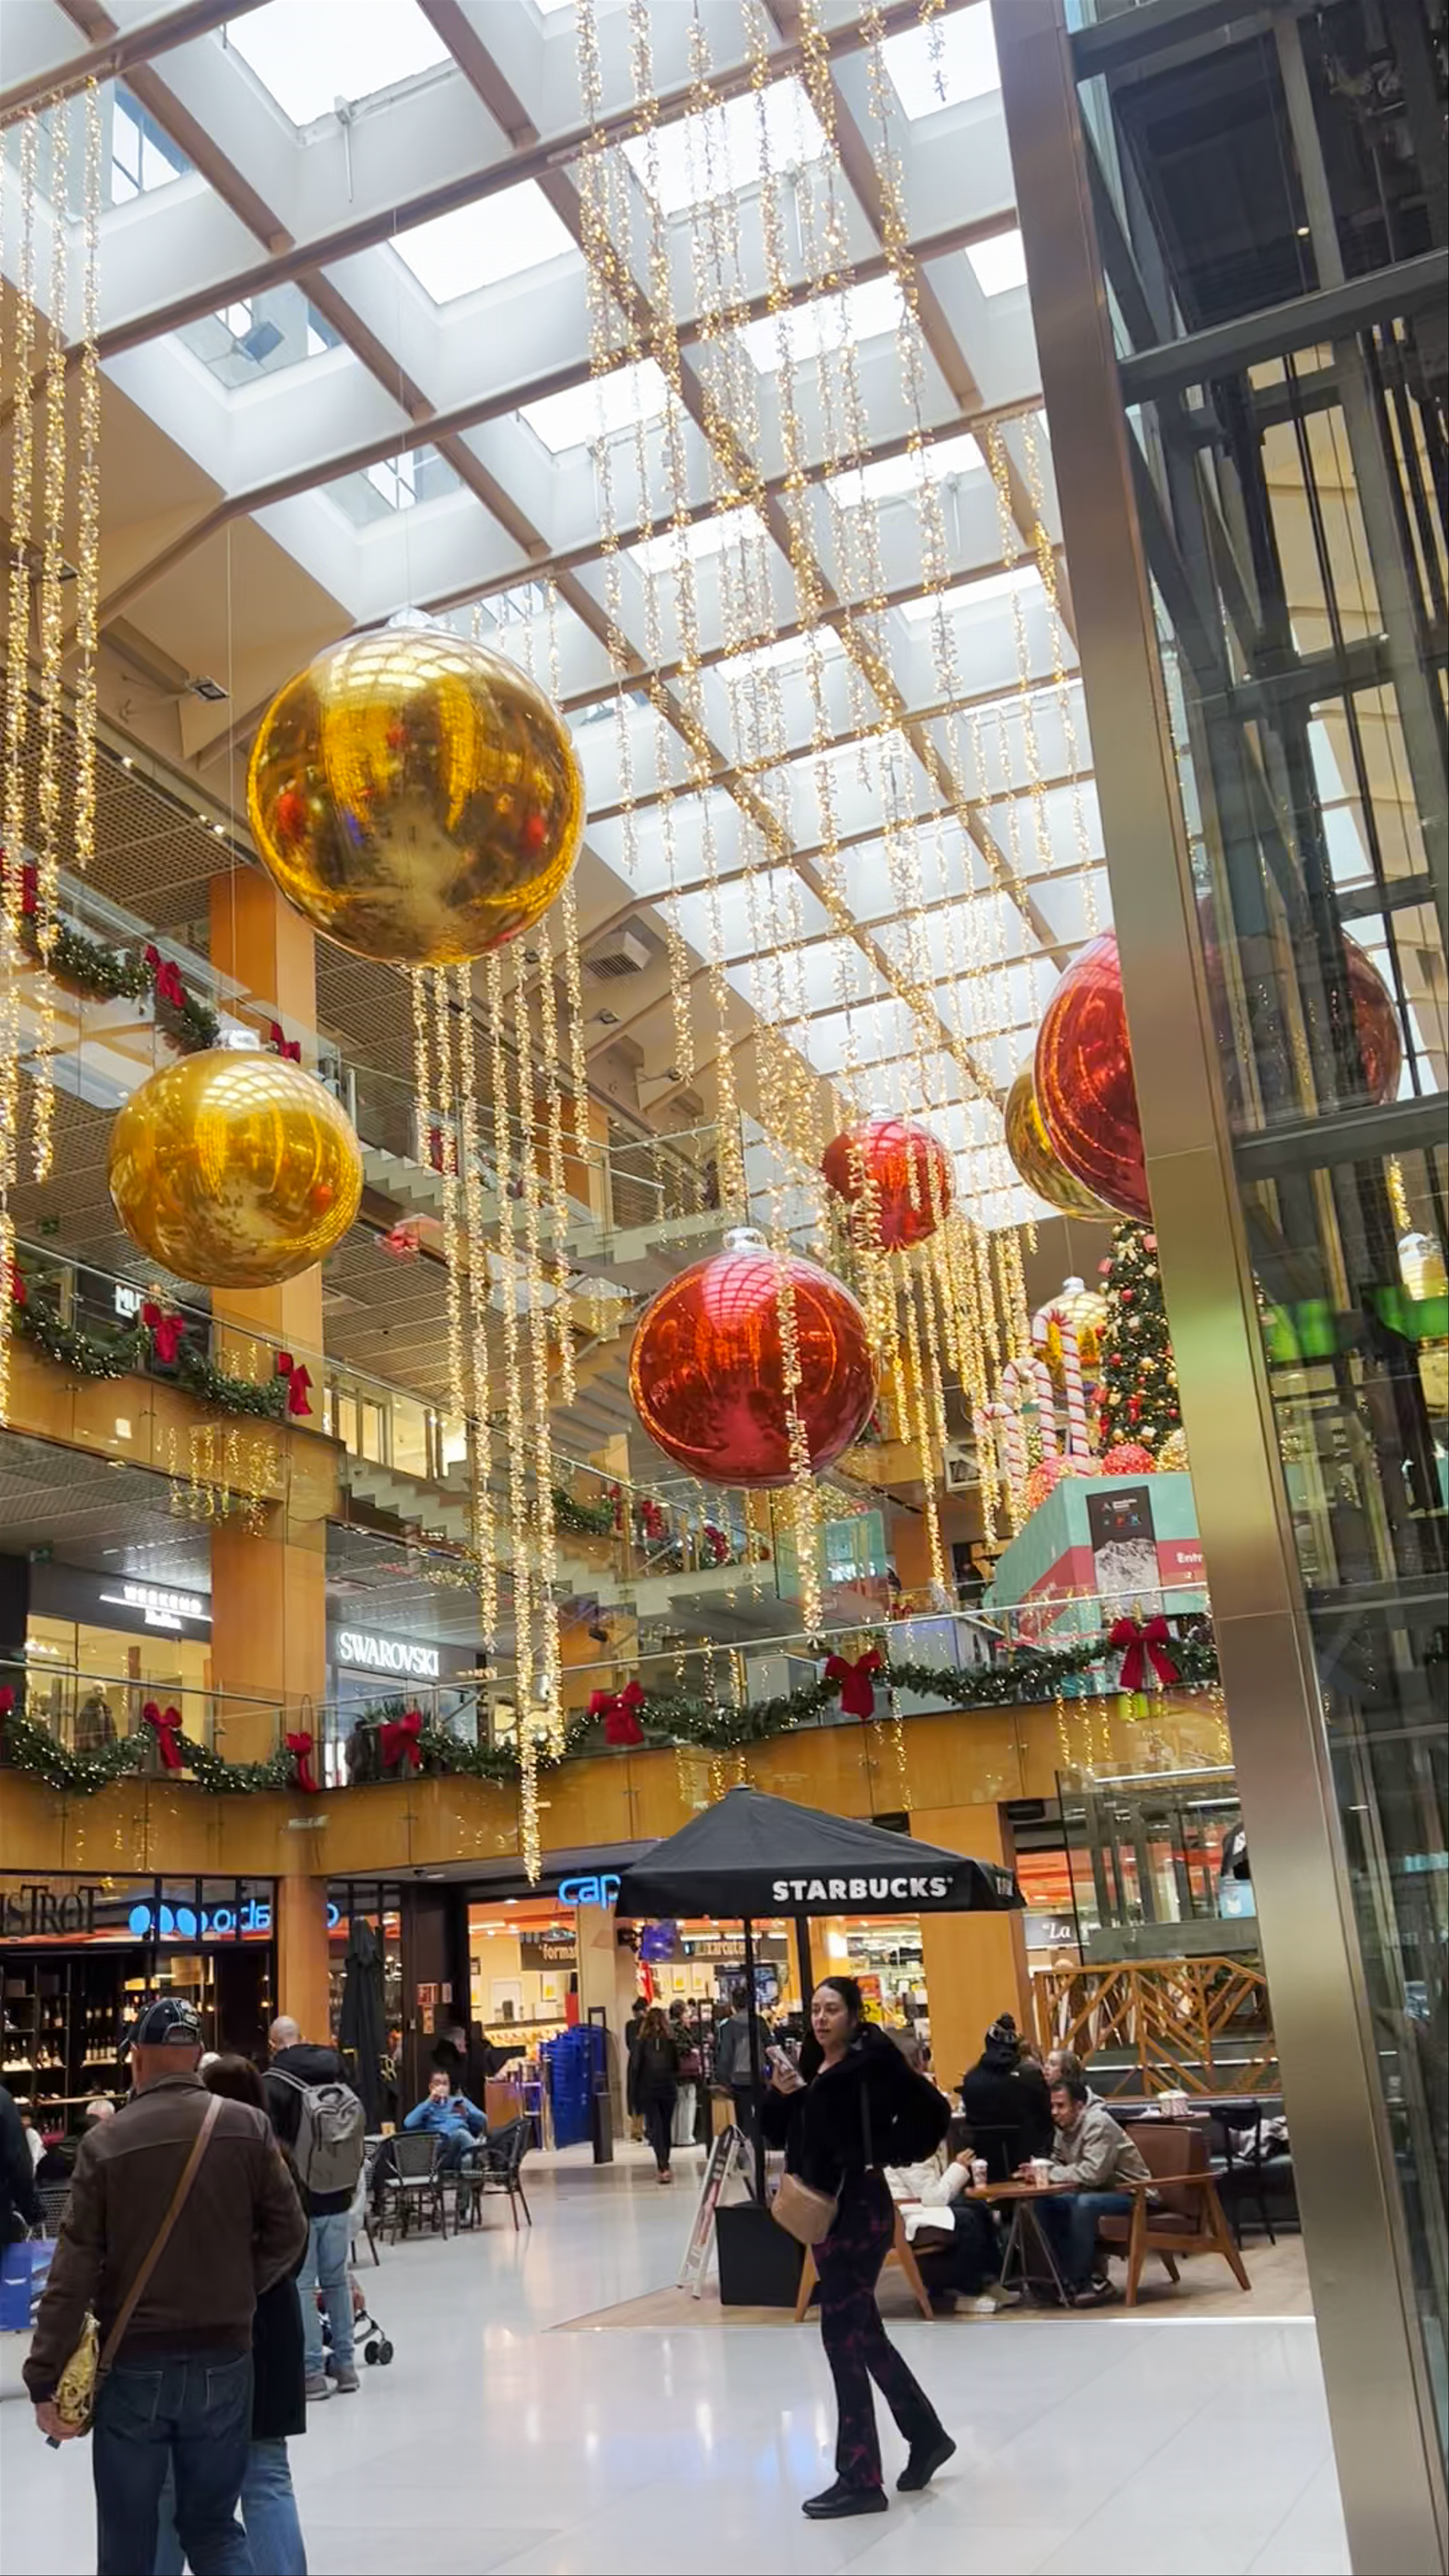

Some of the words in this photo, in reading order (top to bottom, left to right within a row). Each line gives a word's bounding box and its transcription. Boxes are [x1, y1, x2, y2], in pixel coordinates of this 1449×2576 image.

[123, 1586, 202, 1615] WEEKEND
[340, 1631, 440, 1677] SWAROVSKI
[772, 1877, 946, 1901] STARBUCKS
